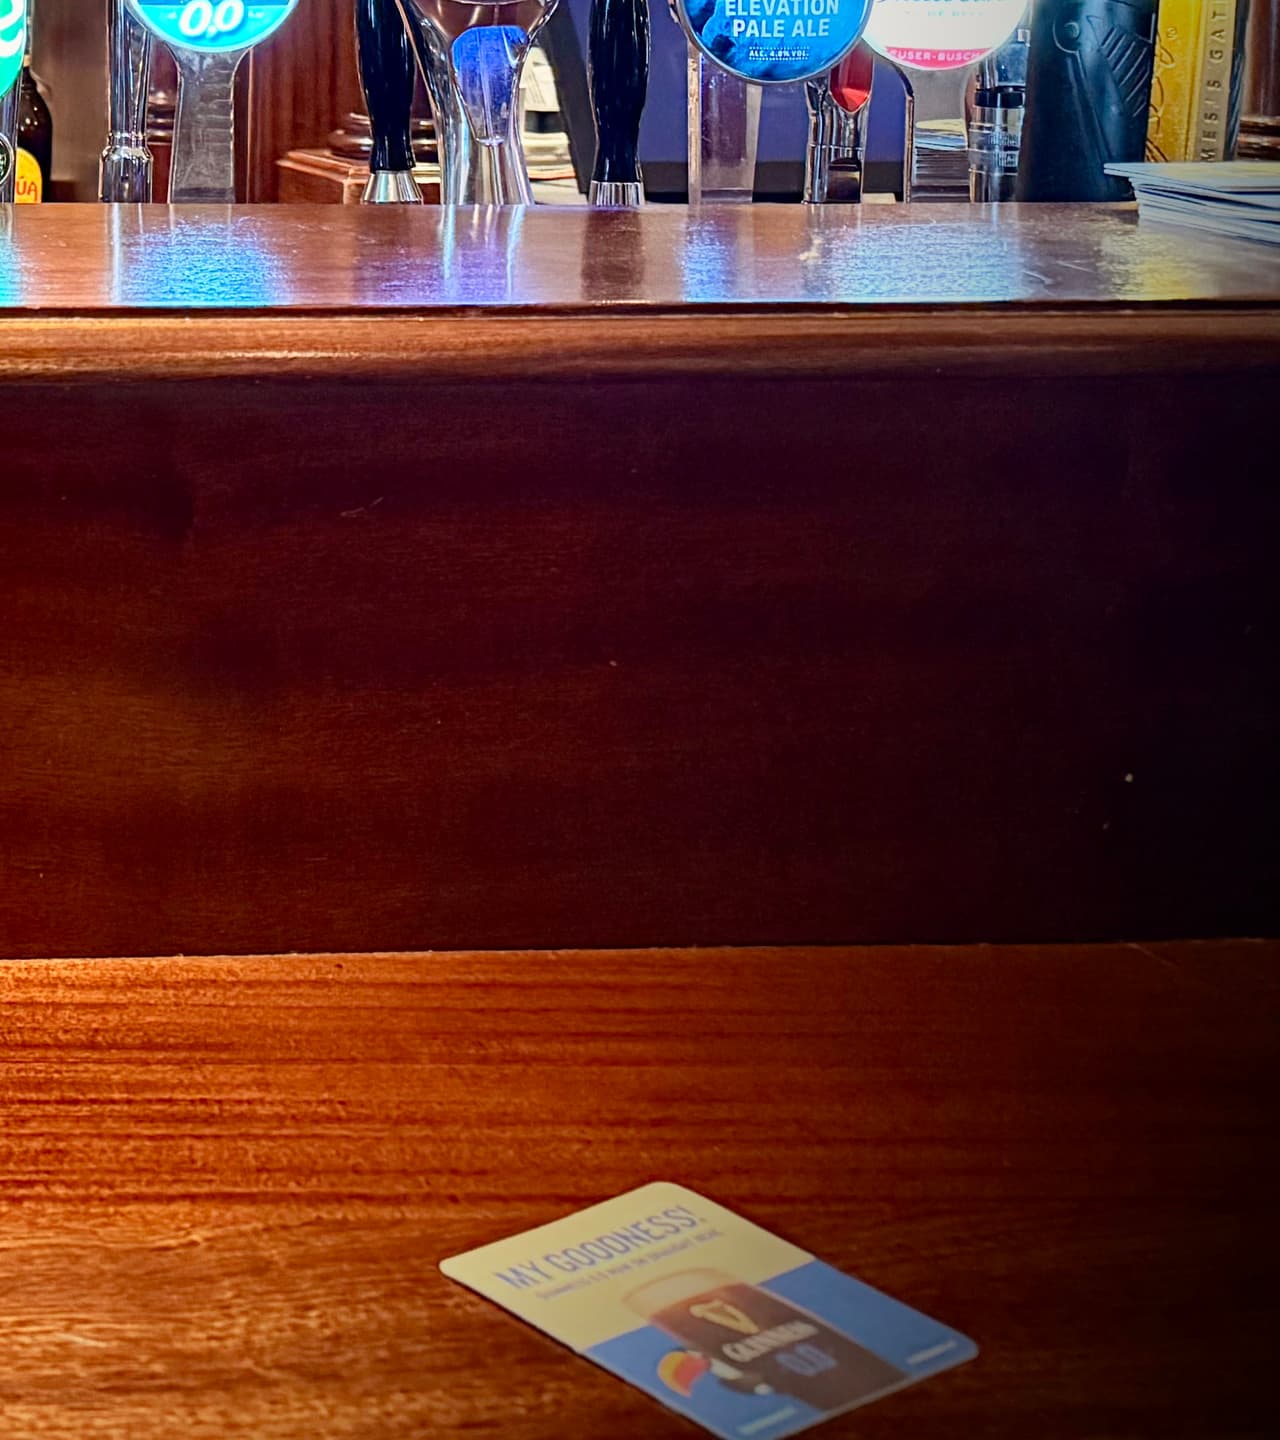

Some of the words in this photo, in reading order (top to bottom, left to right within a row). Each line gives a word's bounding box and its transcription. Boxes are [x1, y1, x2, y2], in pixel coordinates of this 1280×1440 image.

[732, 18, 785, 38] PALE
[791, 17, 831, 38] ALE
[494, 1260, 553, 1290] MY
